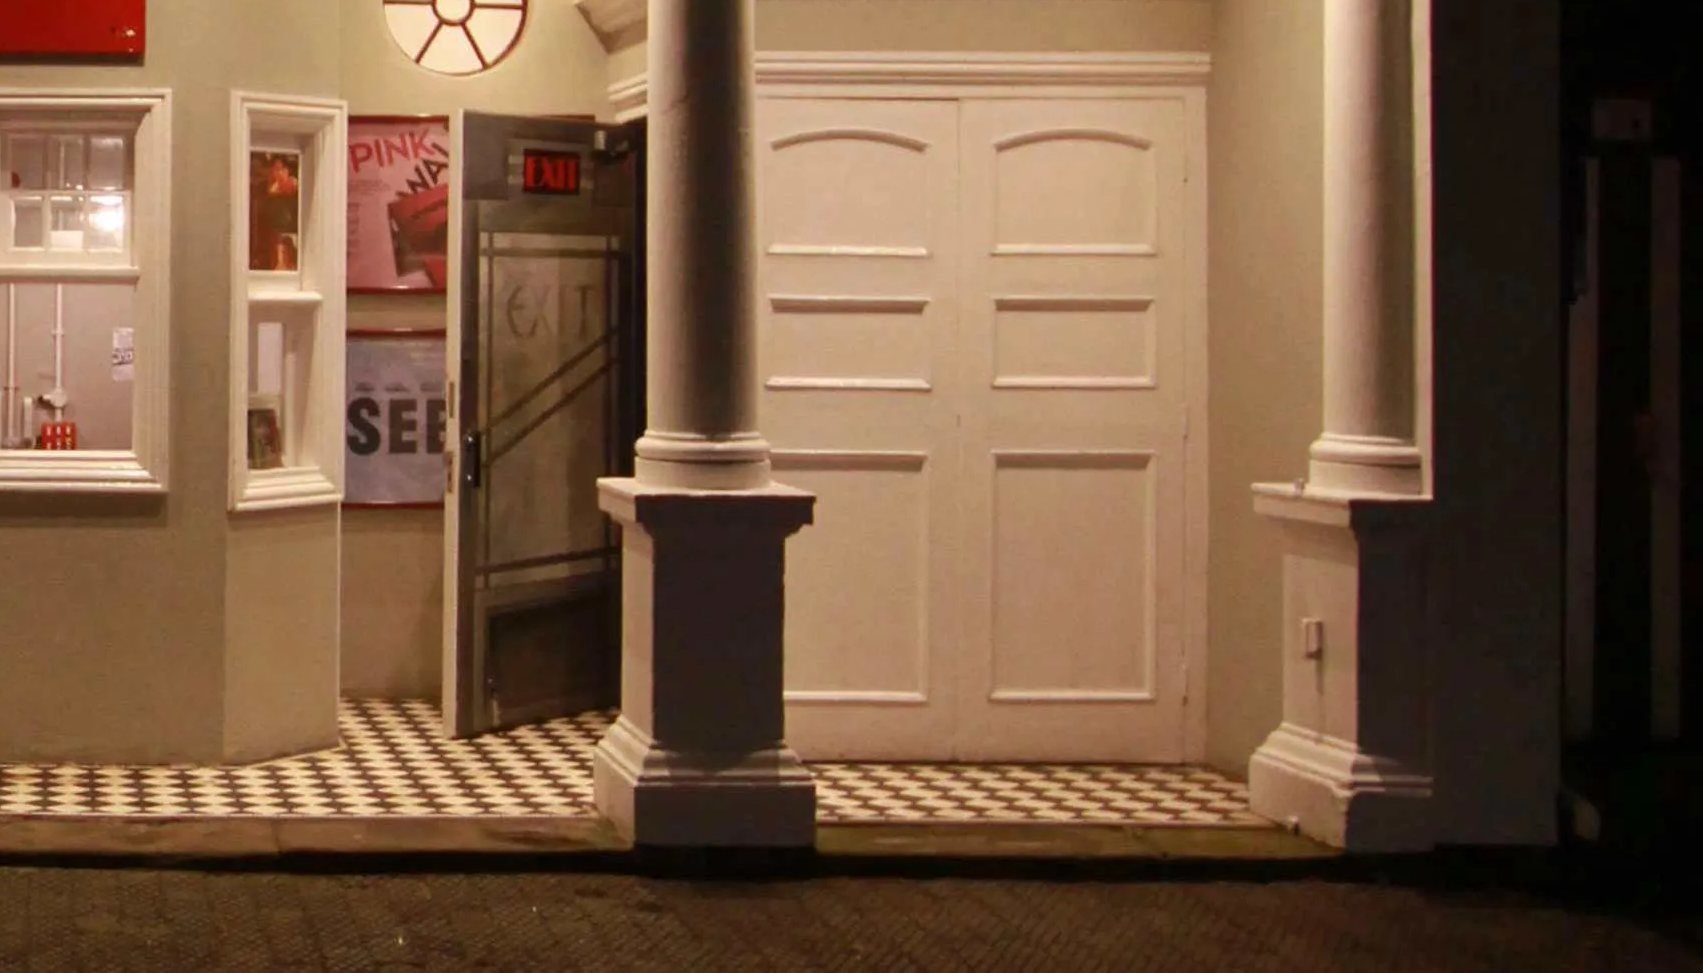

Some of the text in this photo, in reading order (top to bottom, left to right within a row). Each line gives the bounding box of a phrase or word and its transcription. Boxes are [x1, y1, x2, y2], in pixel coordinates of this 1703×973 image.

[349, 128, 435, 173] PINK
[525, 156, 578, 194] EXIT
[506, 284, 599, 343] EXIT
